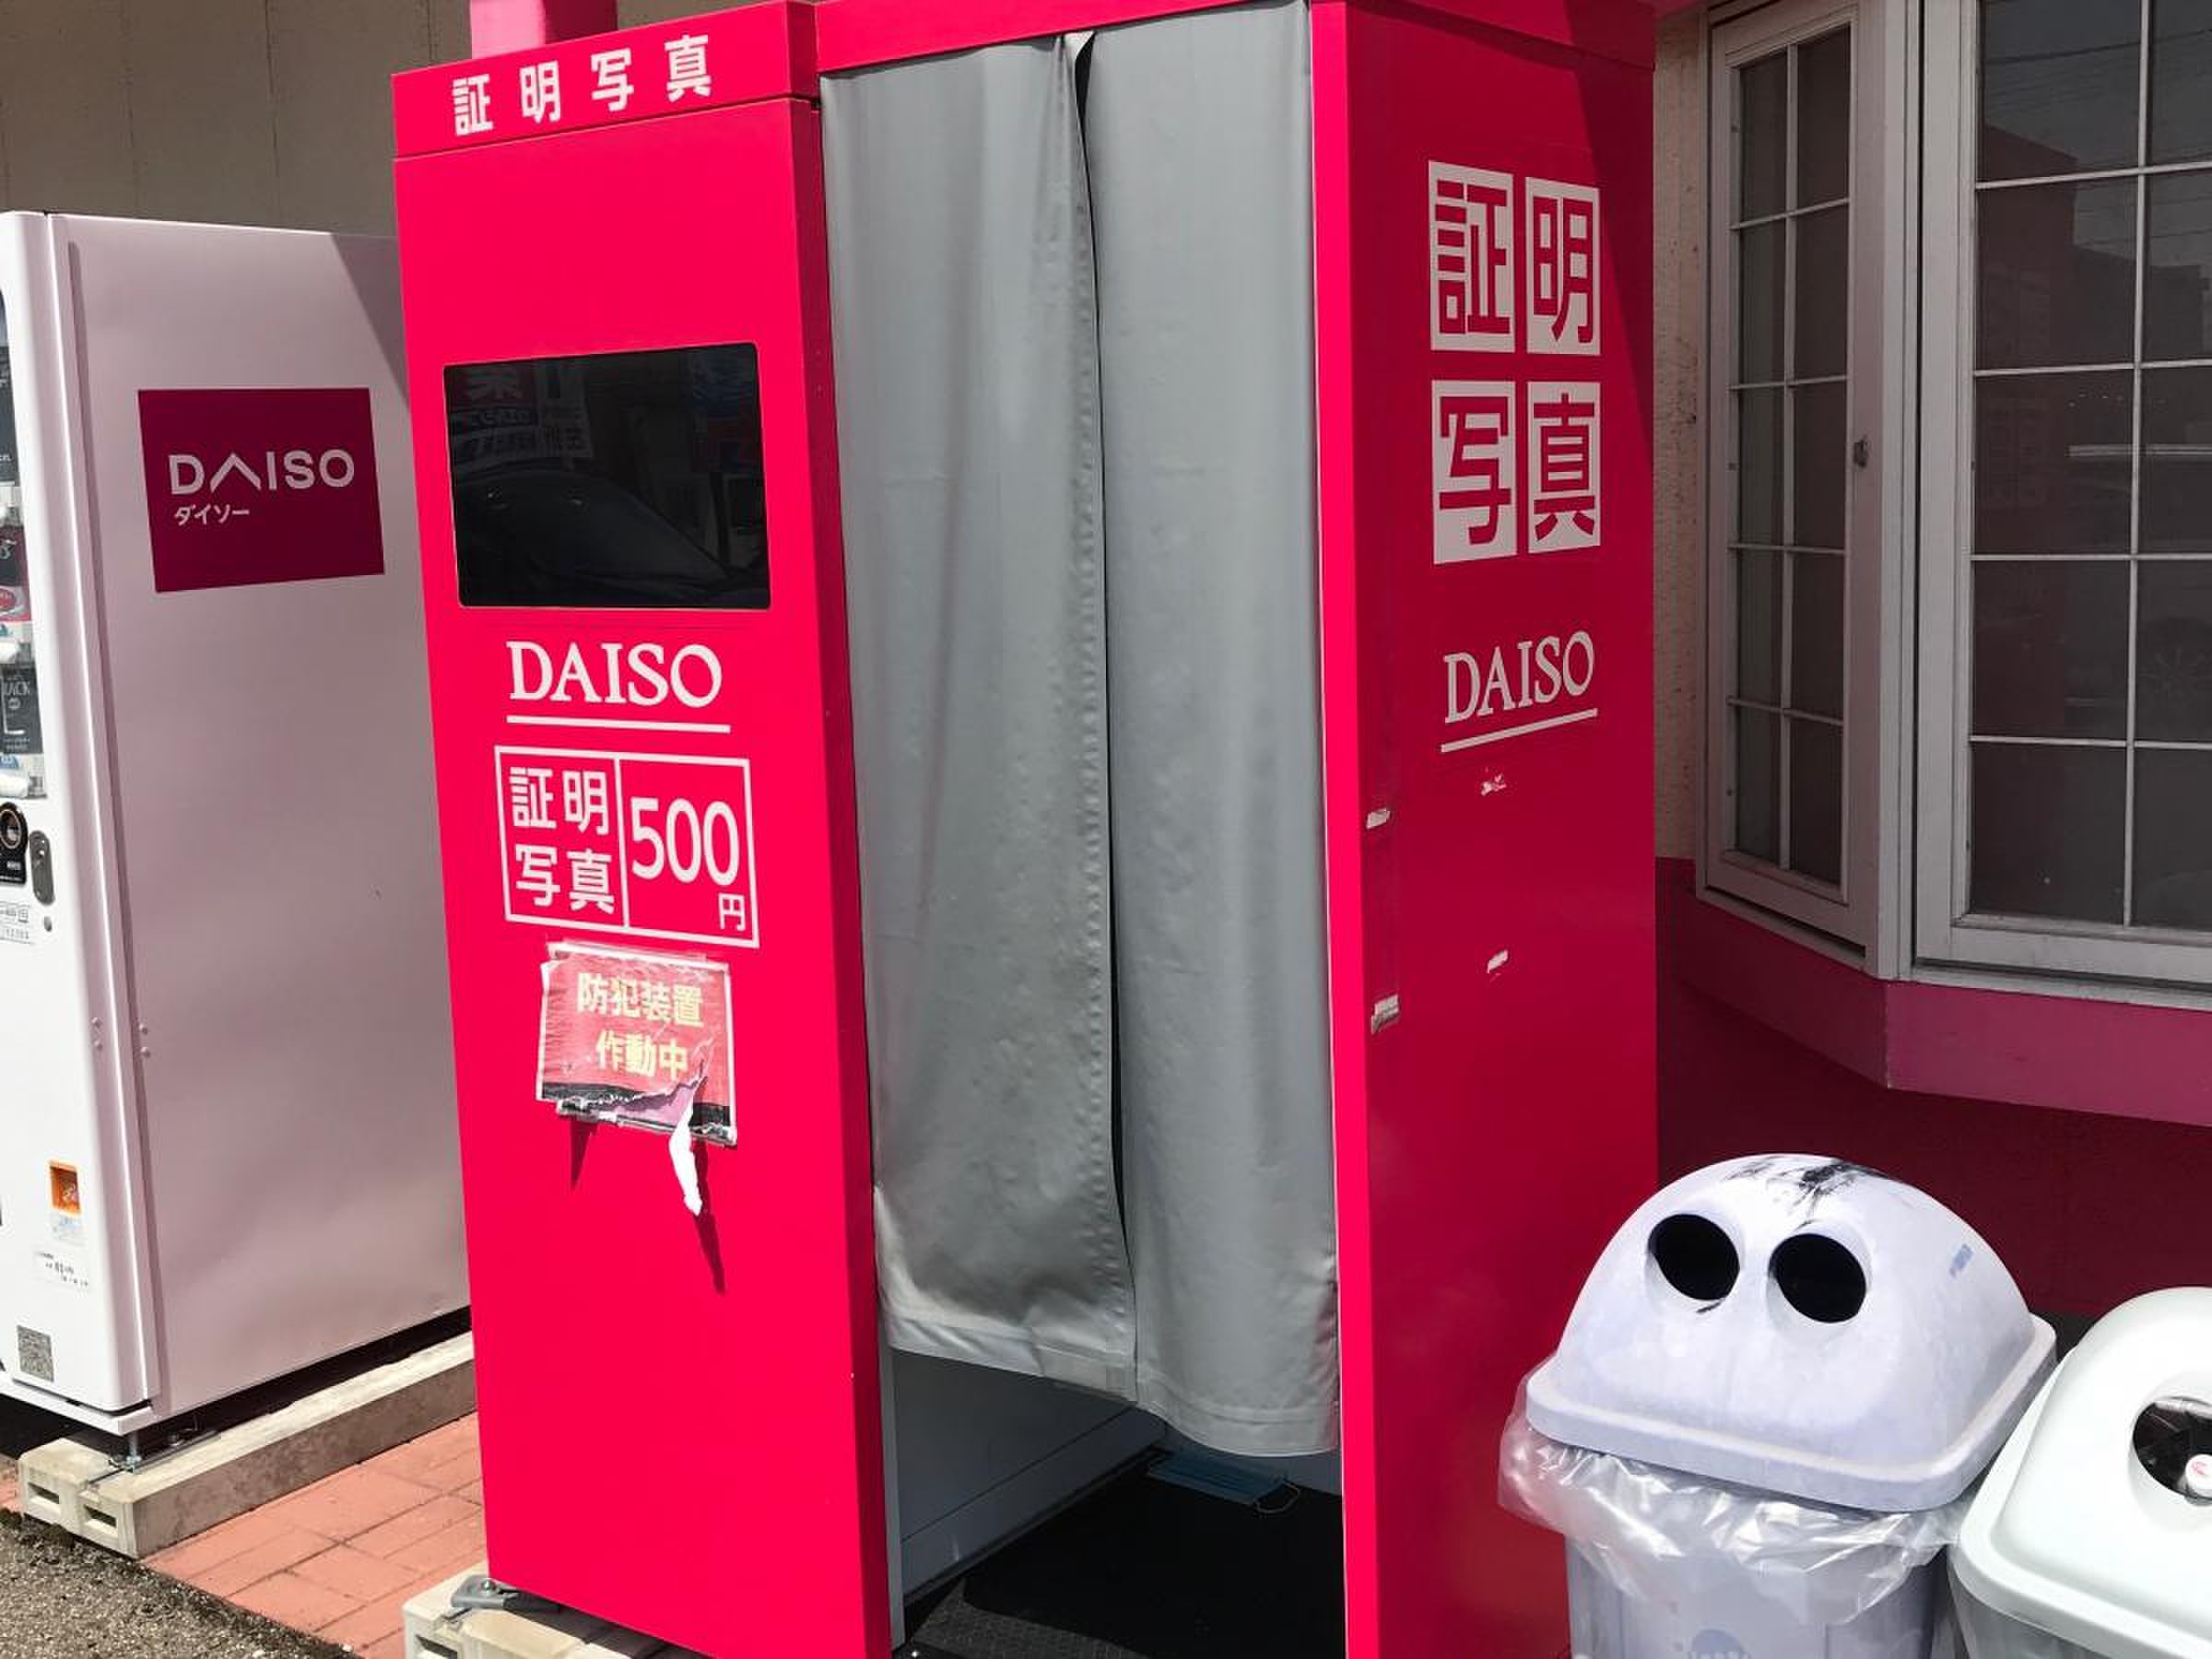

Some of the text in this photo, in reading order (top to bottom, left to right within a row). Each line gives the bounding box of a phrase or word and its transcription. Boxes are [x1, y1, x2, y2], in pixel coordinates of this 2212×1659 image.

[451, 34, 712, 136] 証明写真
[1434, 178, 1594, 343] 証明
[168, 448, 355, 495] DAISO
[1438, 392, 1595, 546] 写真
[173, 503, 251, 526] ダイソー
[506, 640, 723, 708] DAISO
[1442, 630, 1595, 724] DAISO
[509, 766, 610, 835] 証明
[629, 796, 741, 886] 500
[514, 843, 615, 914] 写真
[718, 892, 747, 932] 円
[576, 971, 705, 1029] 防犯装置
[595, 1029, 689, 1082] 作動中
